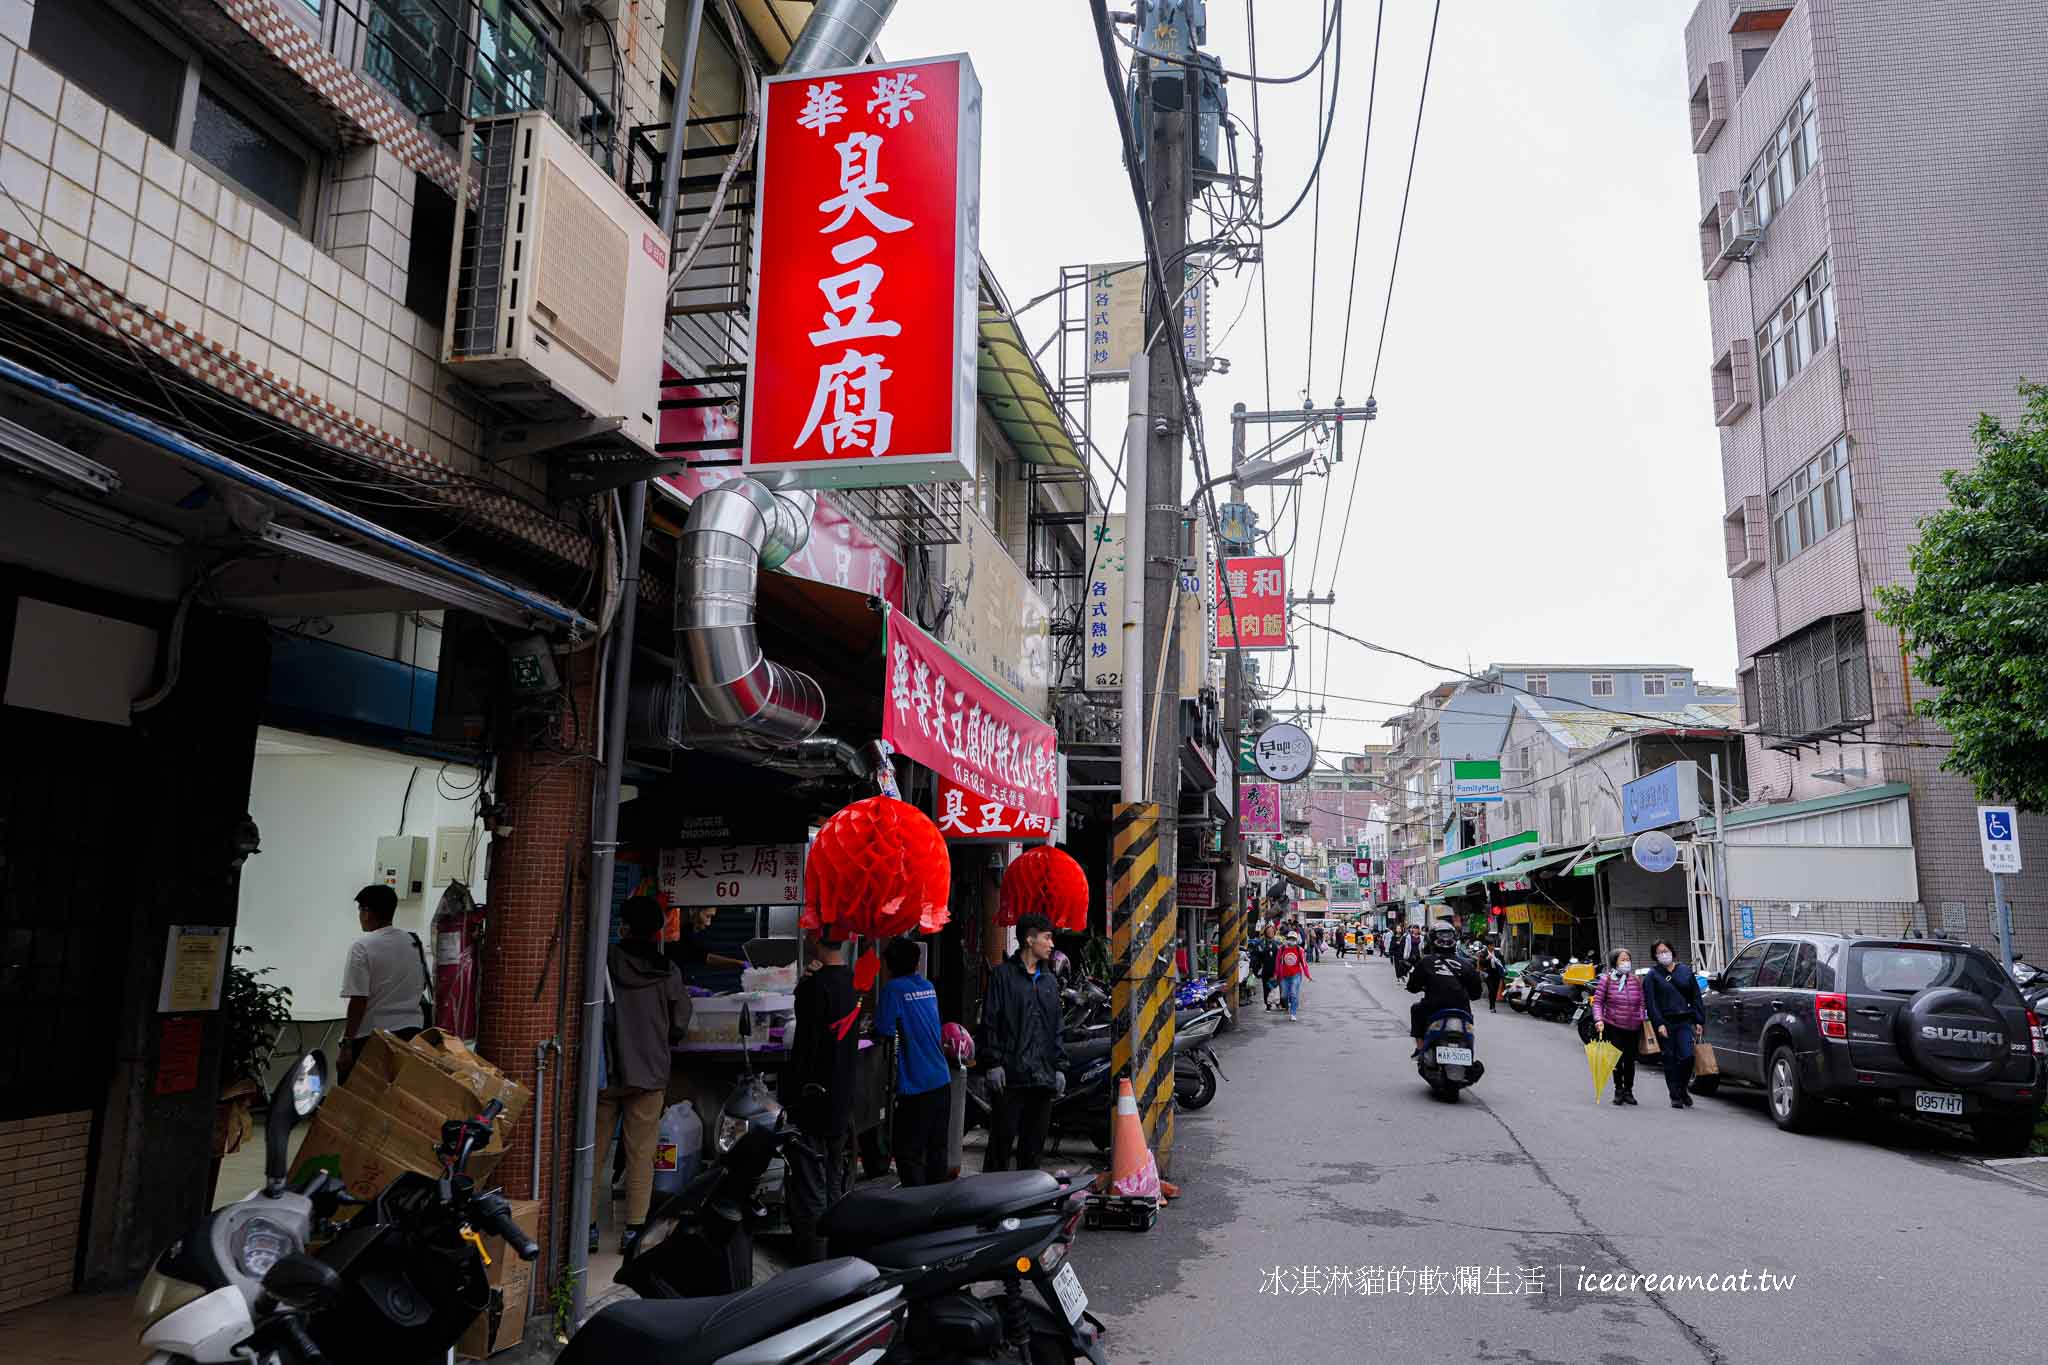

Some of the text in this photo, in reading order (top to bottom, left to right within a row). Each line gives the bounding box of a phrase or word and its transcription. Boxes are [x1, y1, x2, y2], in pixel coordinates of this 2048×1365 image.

[792, 131, 914, 458] 臭豆腐
[1091, 581, 1108, 658] 各式熱炒
[1456, 784, 1500, 792] FamilyMart
[681, 849, 780, 879] 臭豆腐
[716, 881, 740, 897] 60
[1922, 1026, 2003, 1045] SUZUKI
